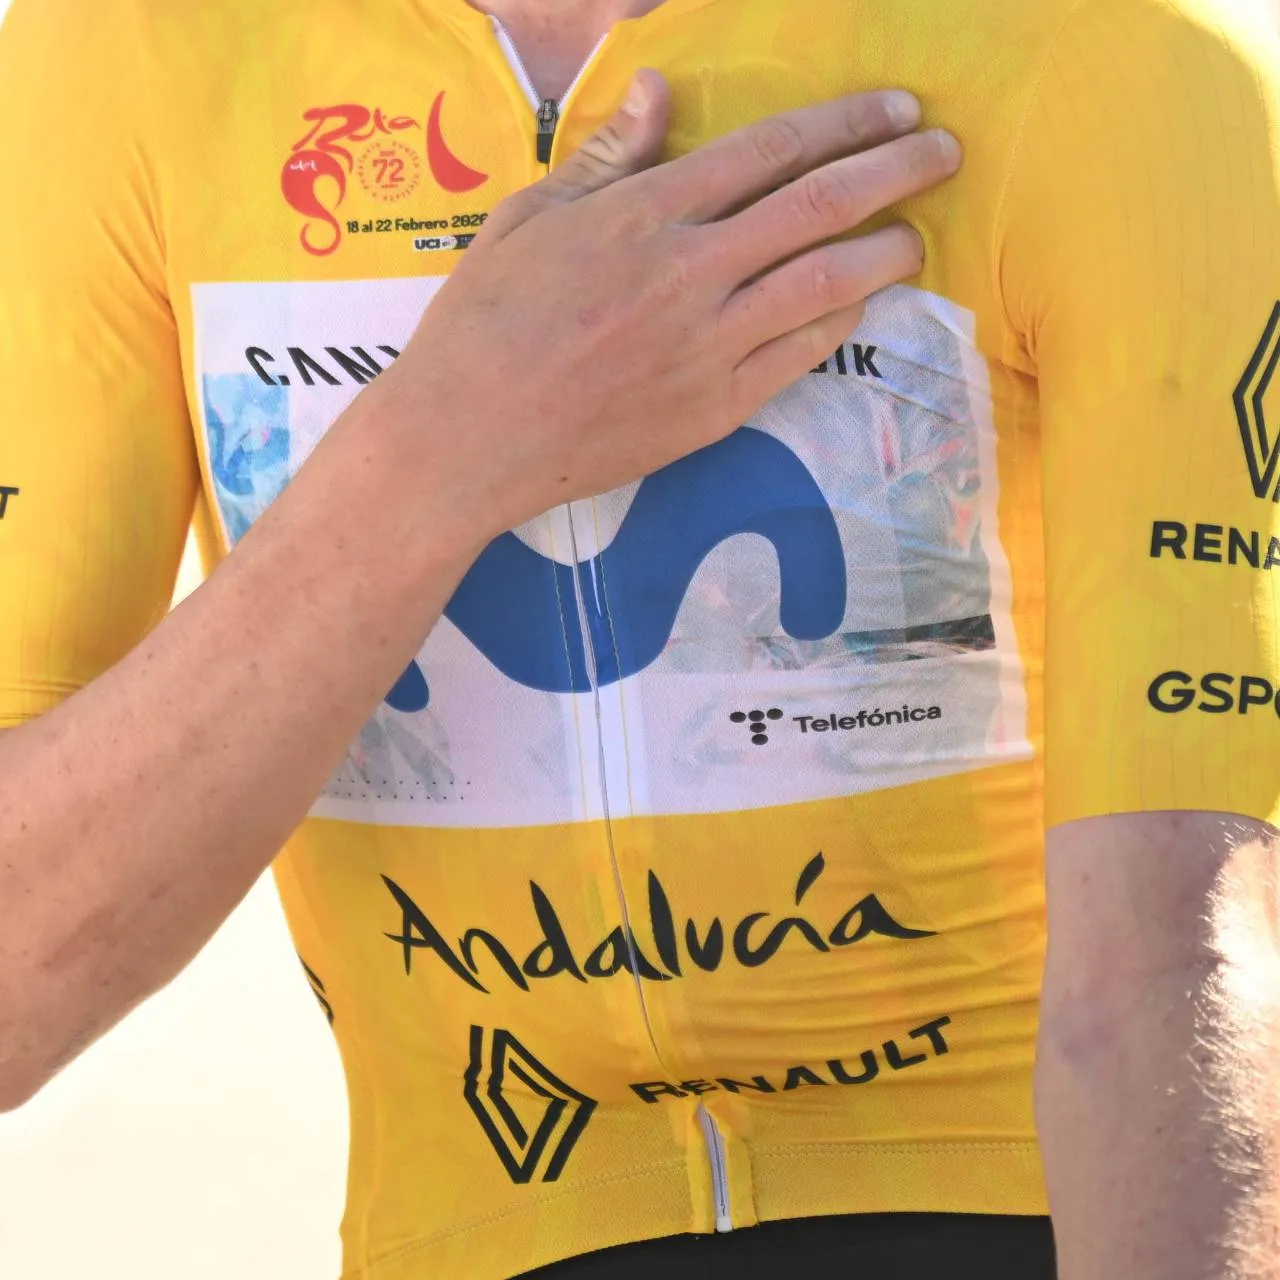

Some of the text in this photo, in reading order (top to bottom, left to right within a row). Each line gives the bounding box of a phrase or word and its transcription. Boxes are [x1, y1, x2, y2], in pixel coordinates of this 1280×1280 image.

[371, 158, 405, 184] 72
[347, 220, 359, 233] 18
[362, 219, 373, 232] al
[376, 219, 392, 232] 22
[395, 217, 448, 231] Febrero
[414, 238, 441, 250] UCI
[245, 345, 401, 386] CAN
[793, 705, 942, 733] Telefónica
[379, 851, 940, 994] Andalucía
[628, 1015, 953, 1104] RENAULT
